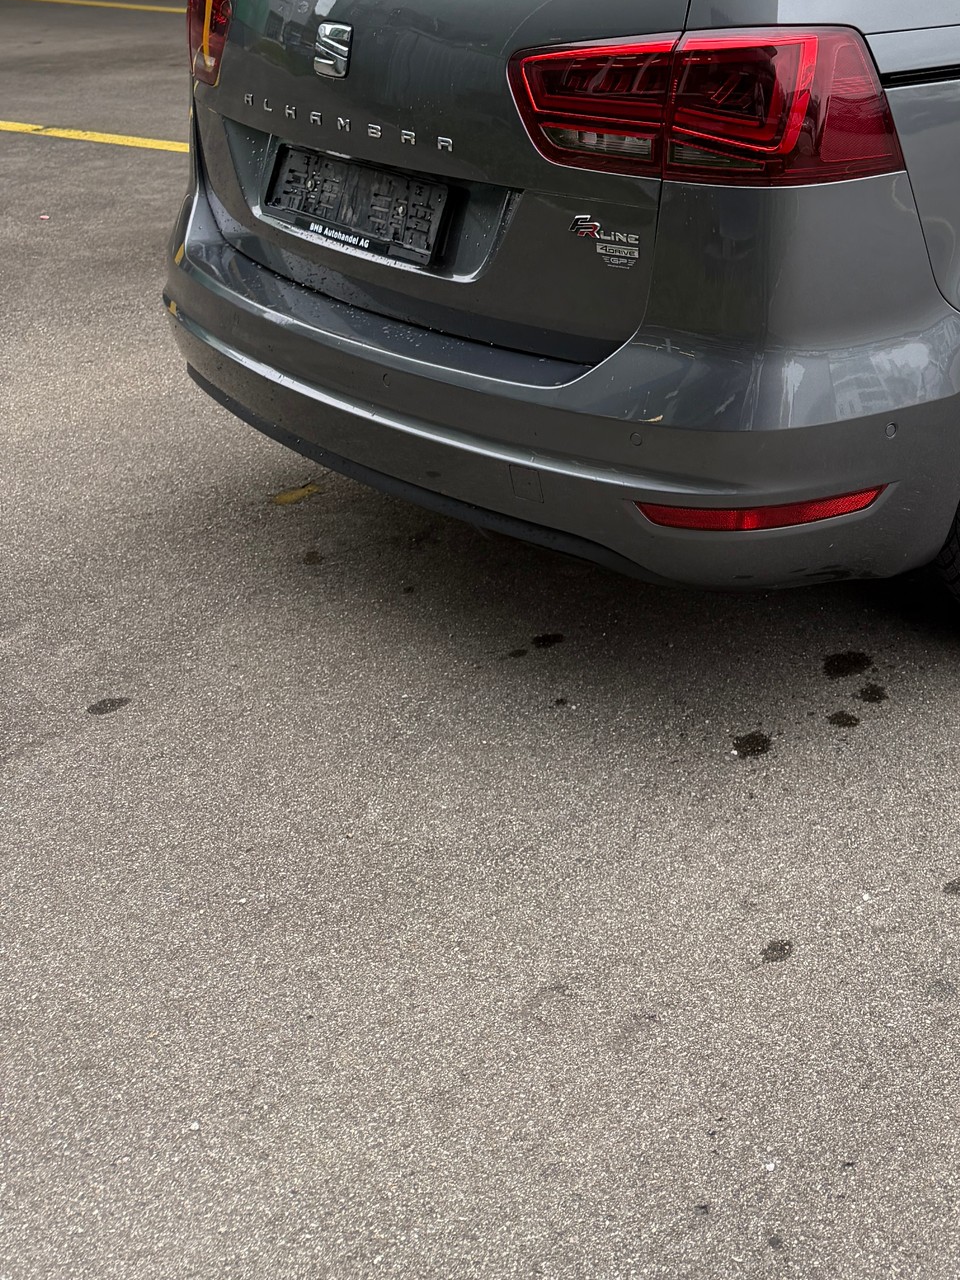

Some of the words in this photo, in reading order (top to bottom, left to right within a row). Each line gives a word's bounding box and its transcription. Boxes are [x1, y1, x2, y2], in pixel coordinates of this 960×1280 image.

[244, 93, 453, 152] ALHAMBRA
[309, 222, 323, 234] BMB
[323, 227, 359, 245] Autohandel
[358, 238, 370, 249] AG
